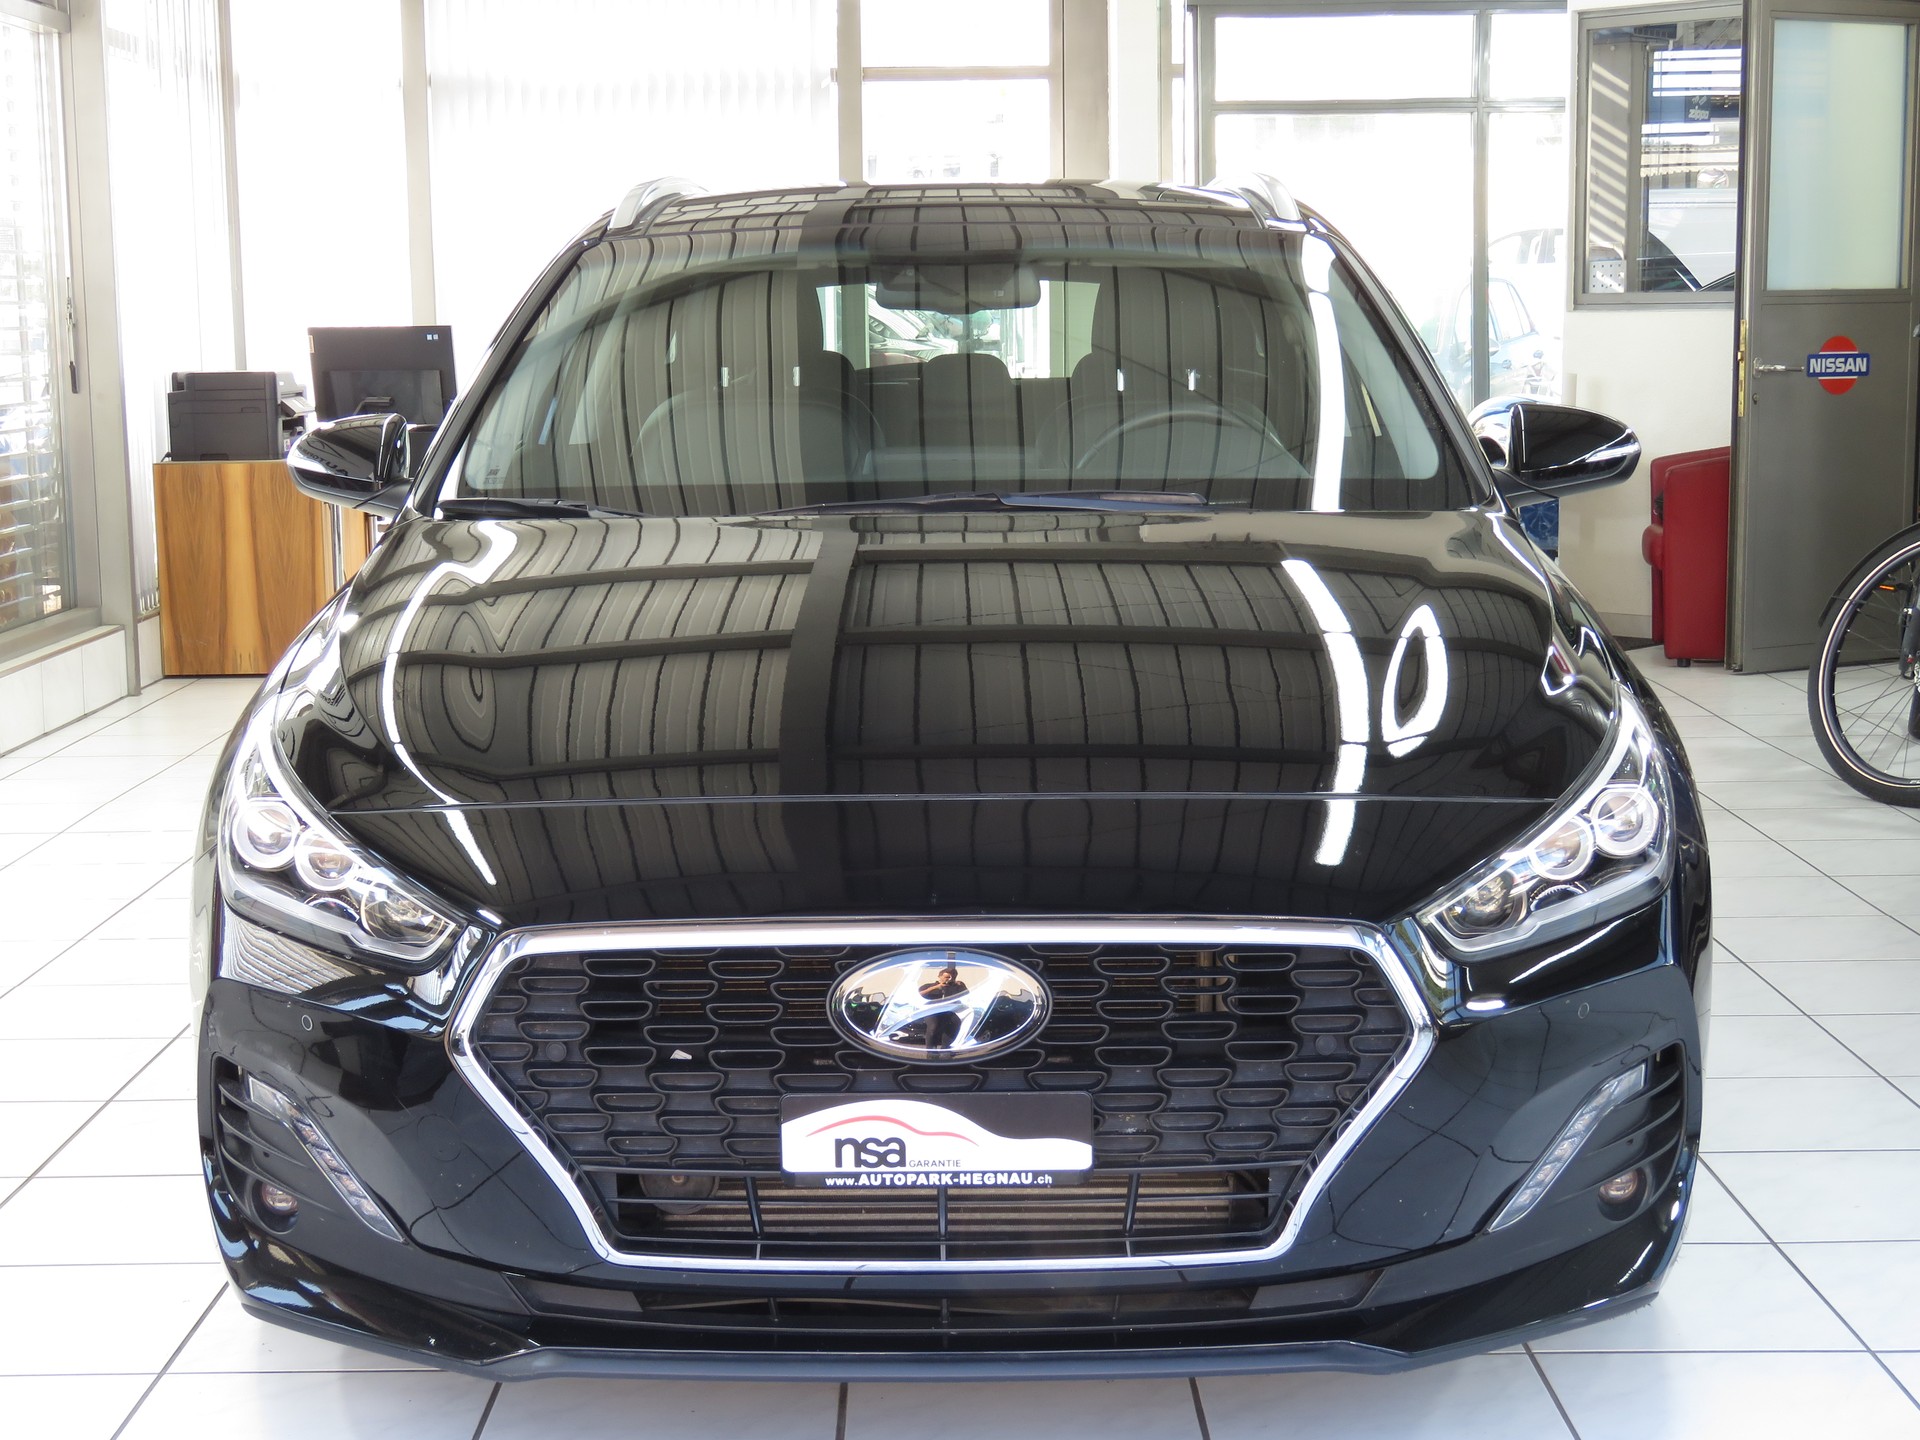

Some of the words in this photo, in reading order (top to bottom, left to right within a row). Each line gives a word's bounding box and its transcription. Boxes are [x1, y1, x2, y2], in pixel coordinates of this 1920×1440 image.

[1809, 357, 1867, 373] NISSAN
[834, 1136, 907, 1169] nsa
[908, 1159, 962, 1168] GARANTIE
[825, 1172, 1053, 1187] www.AUTOPARK-HEGNAU.ch
